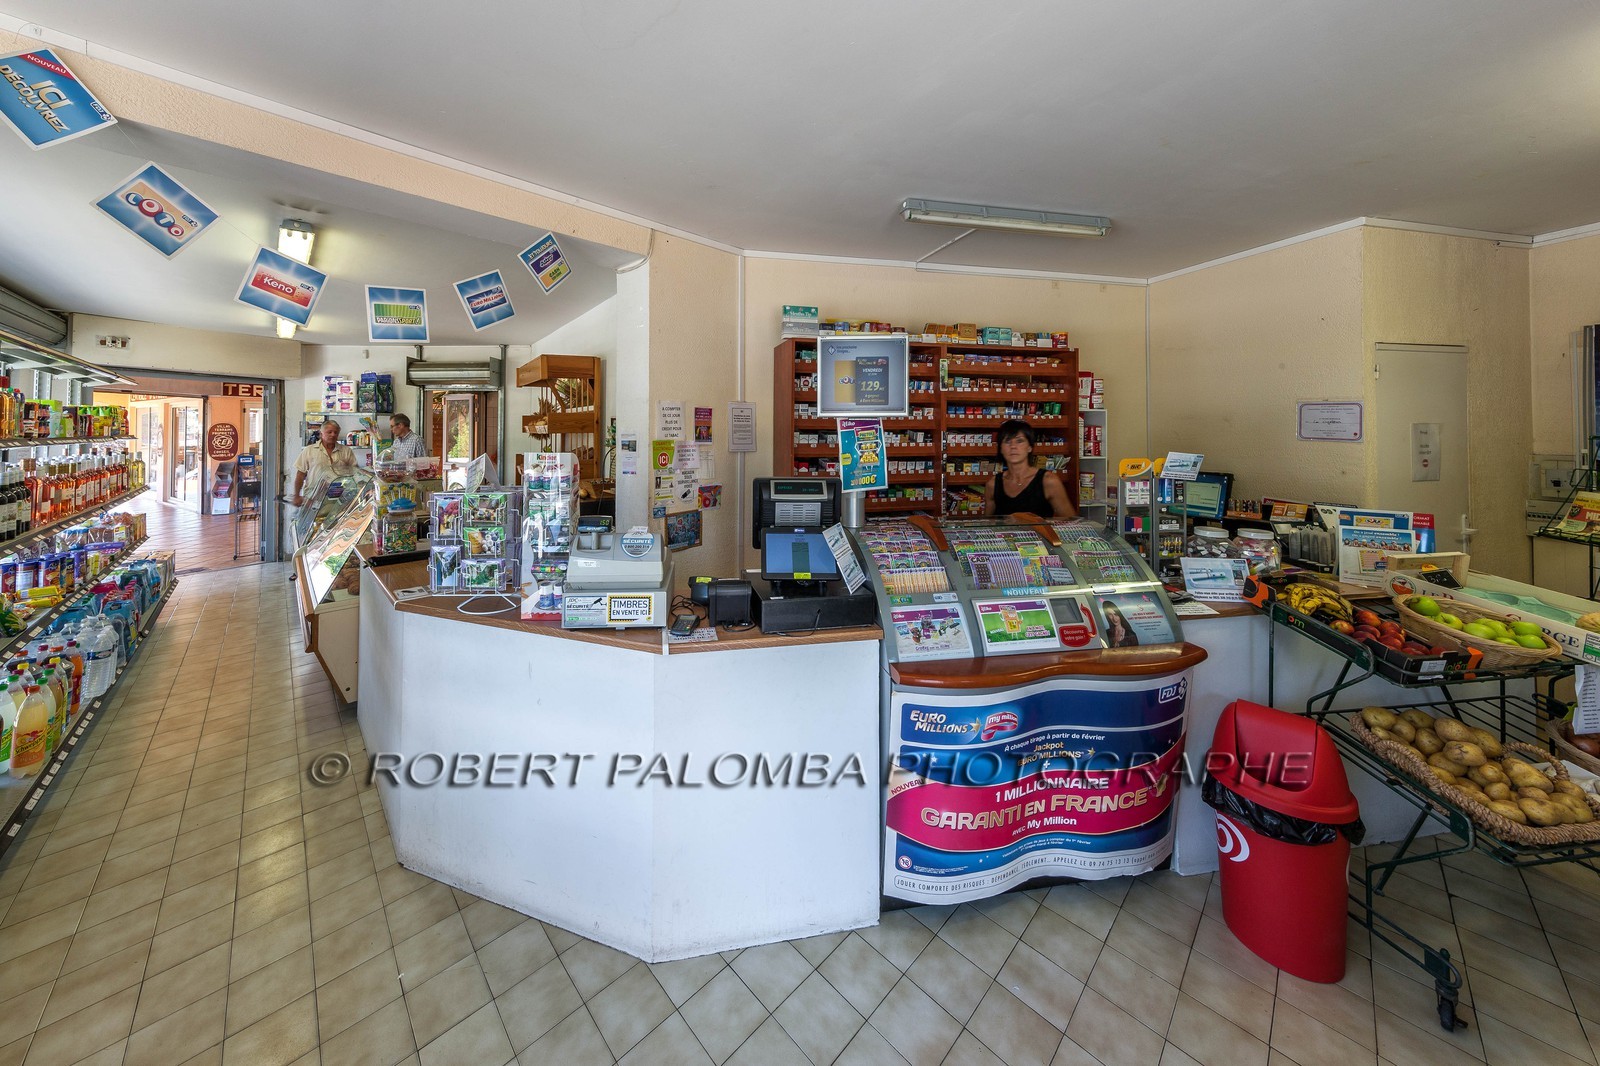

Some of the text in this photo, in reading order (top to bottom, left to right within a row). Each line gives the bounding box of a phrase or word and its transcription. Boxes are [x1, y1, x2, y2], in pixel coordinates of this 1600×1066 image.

[27, 54, 67, 75] NOUVEAU
[0, 64, 71, 133] DÉCOUVREZ
[29, 80, 72, 110] ICI
[125, 192, 184, 236] LOTO
[263, 276, 294, 294] Keno
[860, 380, 880, 391] 129
[659, 455, 668, 464] ICI
[1006, 587, 1046, 596] NOUVEAU
[612, 600, 648, 609] TIMBRES
[1161, 685, 1178, 700] FDJ
[910, 709, 947, 724] EURO
[988, 713, 1018, 725] my million
[1010, 740, 1029, 751] chaque
[1029, 735, 1046, 746] tirage
[1051, 732, 1070, 742] partir
[1033, 741, 1064, 753] Jackpot
[891, 778, 925, 795] NOUVEAU
[995, 777, 1110, 803] 1 MILLIONNAIRE
[920, 787, 1149, 830] GARANTI EN FRANCE
[1012, 816, 1077, 837] AVEC My Million
[897, 879, 916, 889] JOUER
[918, 883, 949, 892] COMPORTE
[963, 879, 985, 889] RISQUES
[1053, 857, 1078, 865] APPELEZ
